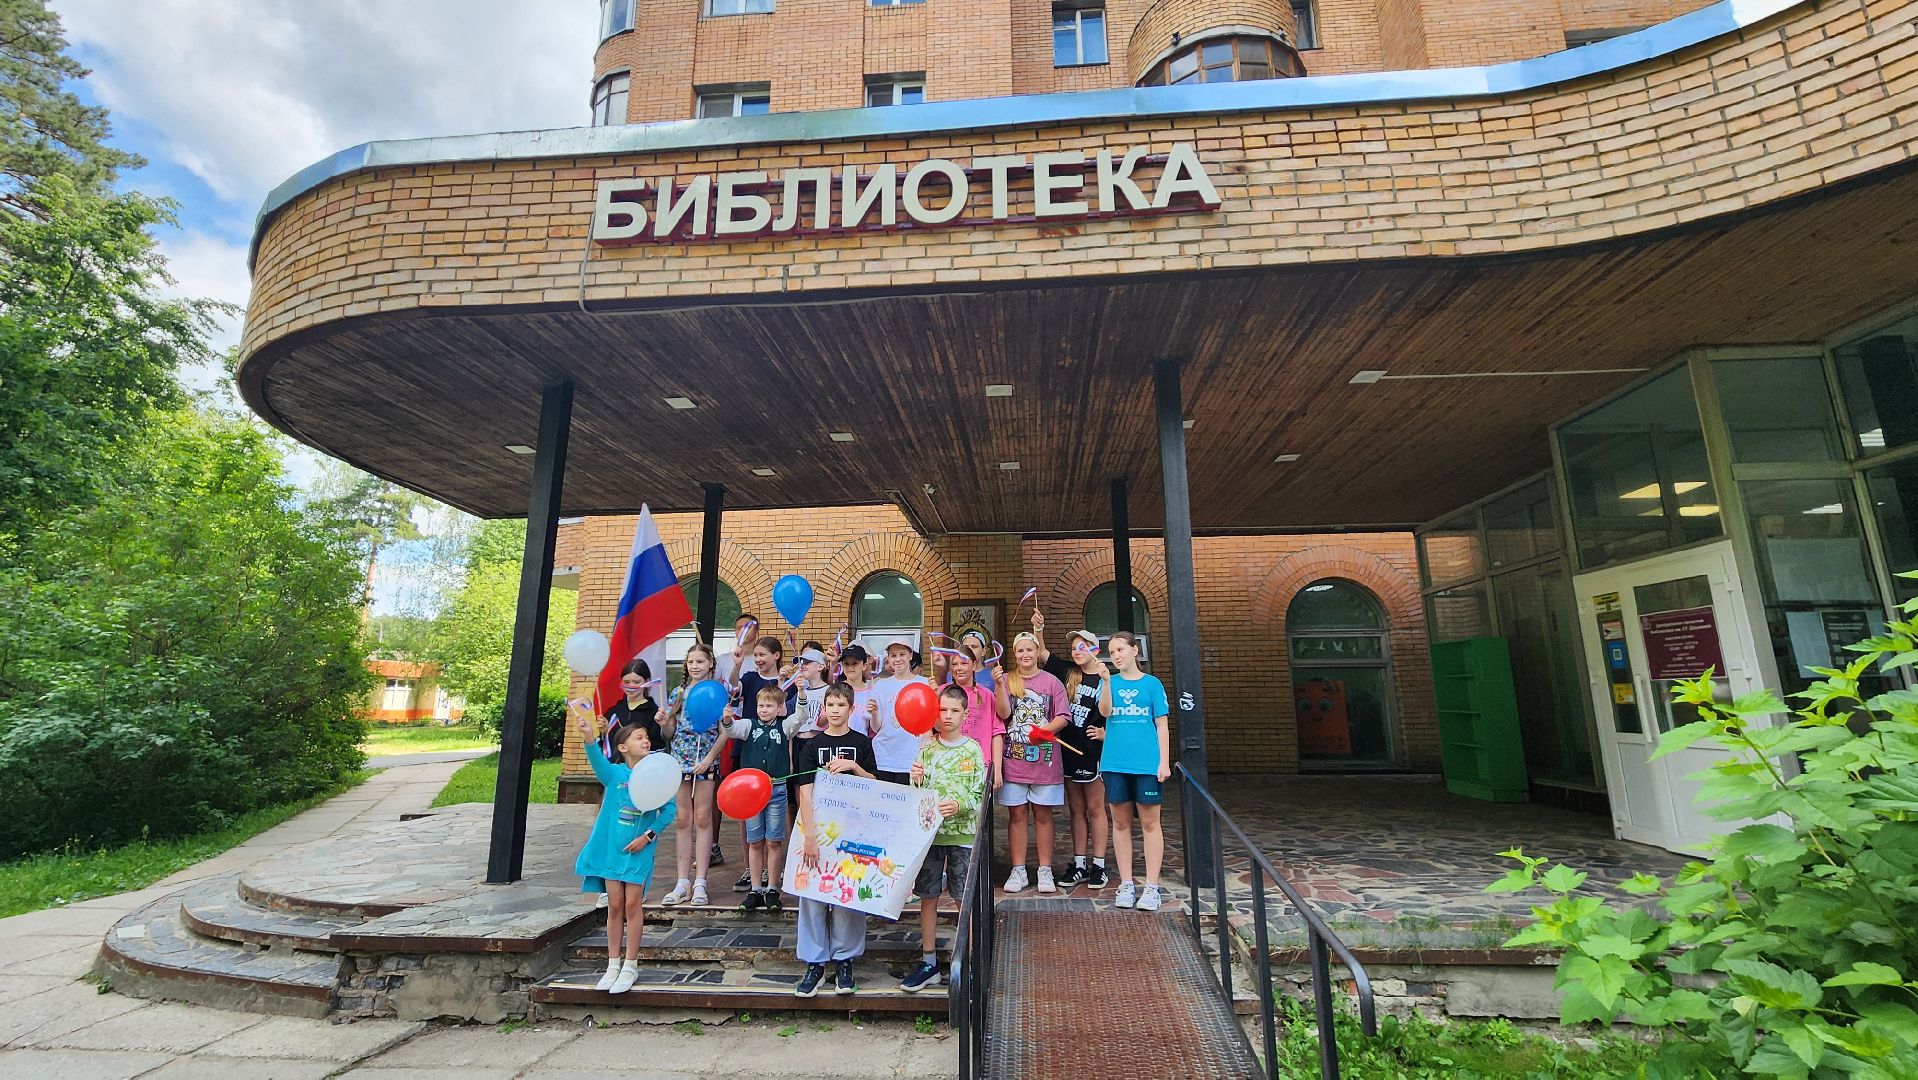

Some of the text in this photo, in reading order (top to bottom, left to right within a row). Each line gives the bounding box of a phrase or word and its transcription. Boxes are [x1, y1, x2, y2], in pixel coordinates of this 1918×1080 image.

[592, 143, 1222, 242] БИБЛИОТЕКА
[821, 774, 870, 790] Я пожелать
[819, 796, 848, 809] стране
[880, 791, 906, 803] своей
